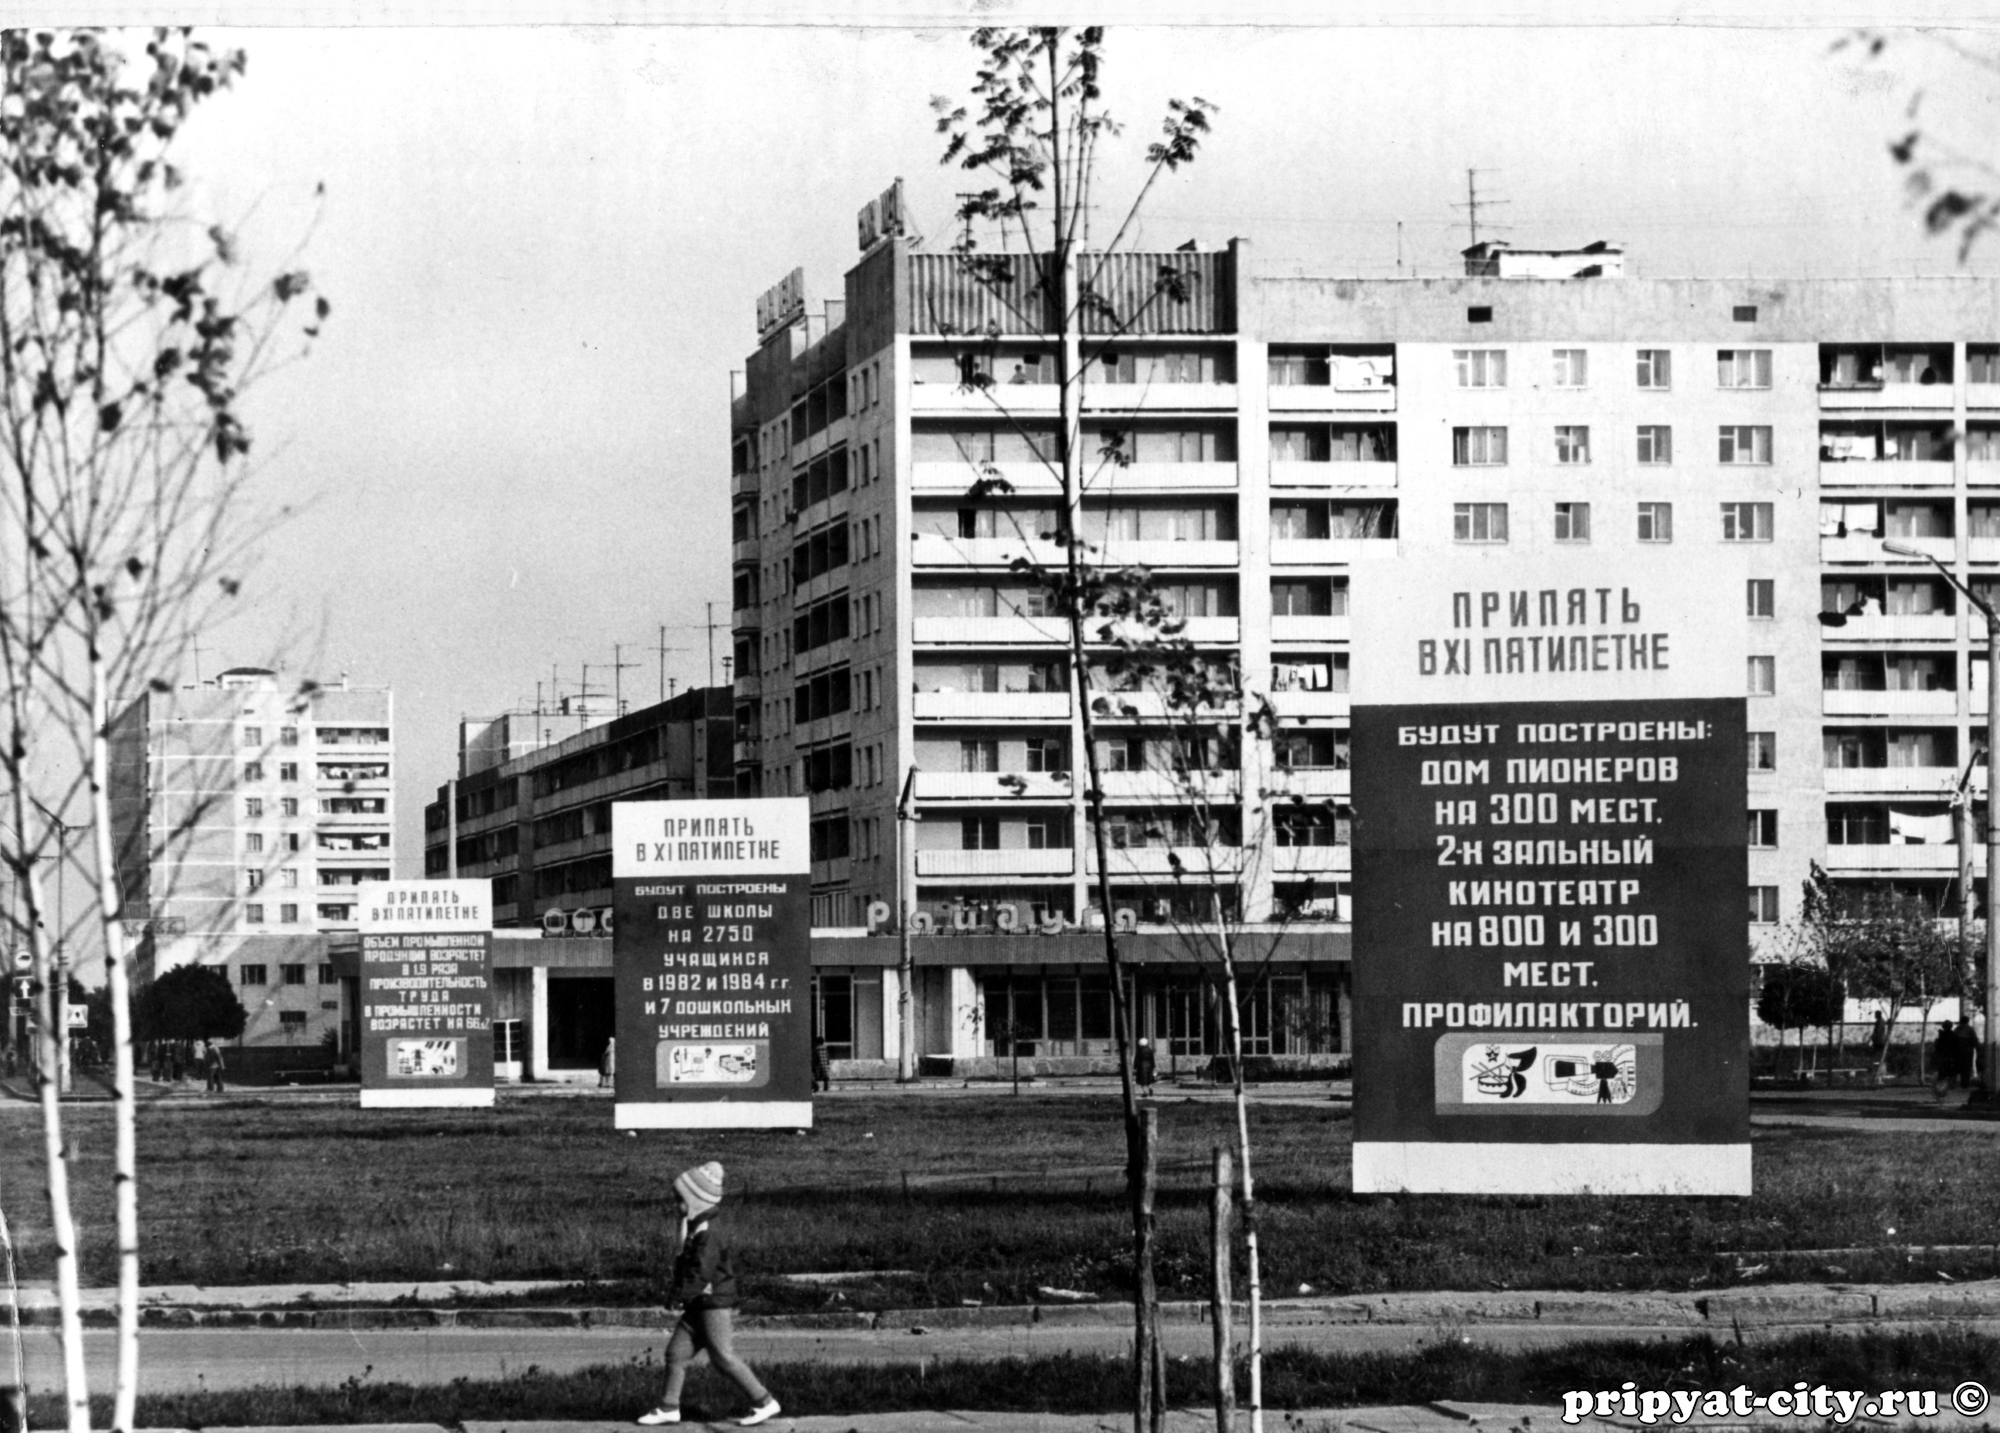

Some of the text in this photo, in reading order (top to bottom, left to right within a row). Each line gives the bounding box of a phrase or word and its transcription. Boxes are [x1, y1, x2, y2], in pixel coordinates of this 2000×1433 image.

[1453, 587, 1641, 628] ПРИПЯТЬ
[1483, 633, 1670, 674] ПЯТИЛЕТКЕ
[1398, 720, 1713, 746] БУДУТ ПОСТРОЕНЫ:
[1420, 756, 1679, 786] ДОМ ПИОНЕРОВ
[1434, 792, 1663, 825] НА 300 МЕСТ.
[664, 816, 754, 838] ПРИПЯТЬ
[636, 843, 646, 862] В
[678, 840, 780, 861] ПЯТИЛЕТКЕ
[1492, 833, 1654, 865] ЗАЛЬНЫЙ
[387, 890, 460, 905] ПРИПЯТЬ
[635, 882, 787, 896] БУДУТ ПОСТРОЕНЫ
[1448, 879, 1641, 906] КИНОТЕАТР
[371, 907, 380, 922] В
[397, 905, 479, 921] ПЯТИЛЕТКЕ
[657, 904, 773, 919] ДВЕ ШКОЛЫ
[668, 925, 754, 943] НА 2750
[1431, 914, 1659, 947] НА 800 И 300
[363, 934, 485, 948] ОБЪЕМ ПРОМЫШЛЕННОЙ
[364, 948, 486, 963] ПРОДУКЦИИ ВОЗРАСТЕТ
[663, 952, 769, 967] УЧАЩИХСЯ
[401, 963, 409, 976] В
[431, 962, 458, 976] РАЗА
[1503, 961, 1599, 987] МЕСТ.
[369, 976, 488, 990] ПРОИЗВОДИТЕЛЬНОСТЬ
[658, 973, 701, 991] 1982
[722, 973, 765, 990] 1984
[398, 990, 450, 1003] ТРУДА
[364, 1003, 482, 1018] В ПРОМЫШЛЕННОСТИ
[645, 997, 792, 1015] И 7 ДОШКОЛЬНЫХ
[1402, 998, 1699, 1028] ПРОФИЛАКТОРИЙ.
[370, 1018, 441, 1031] ВОЗРАСТЕТ
[446, 1017, 464, 1030] НА
[658, 1021, 770, 1039] УЧРЕЖДЕНИЙ
